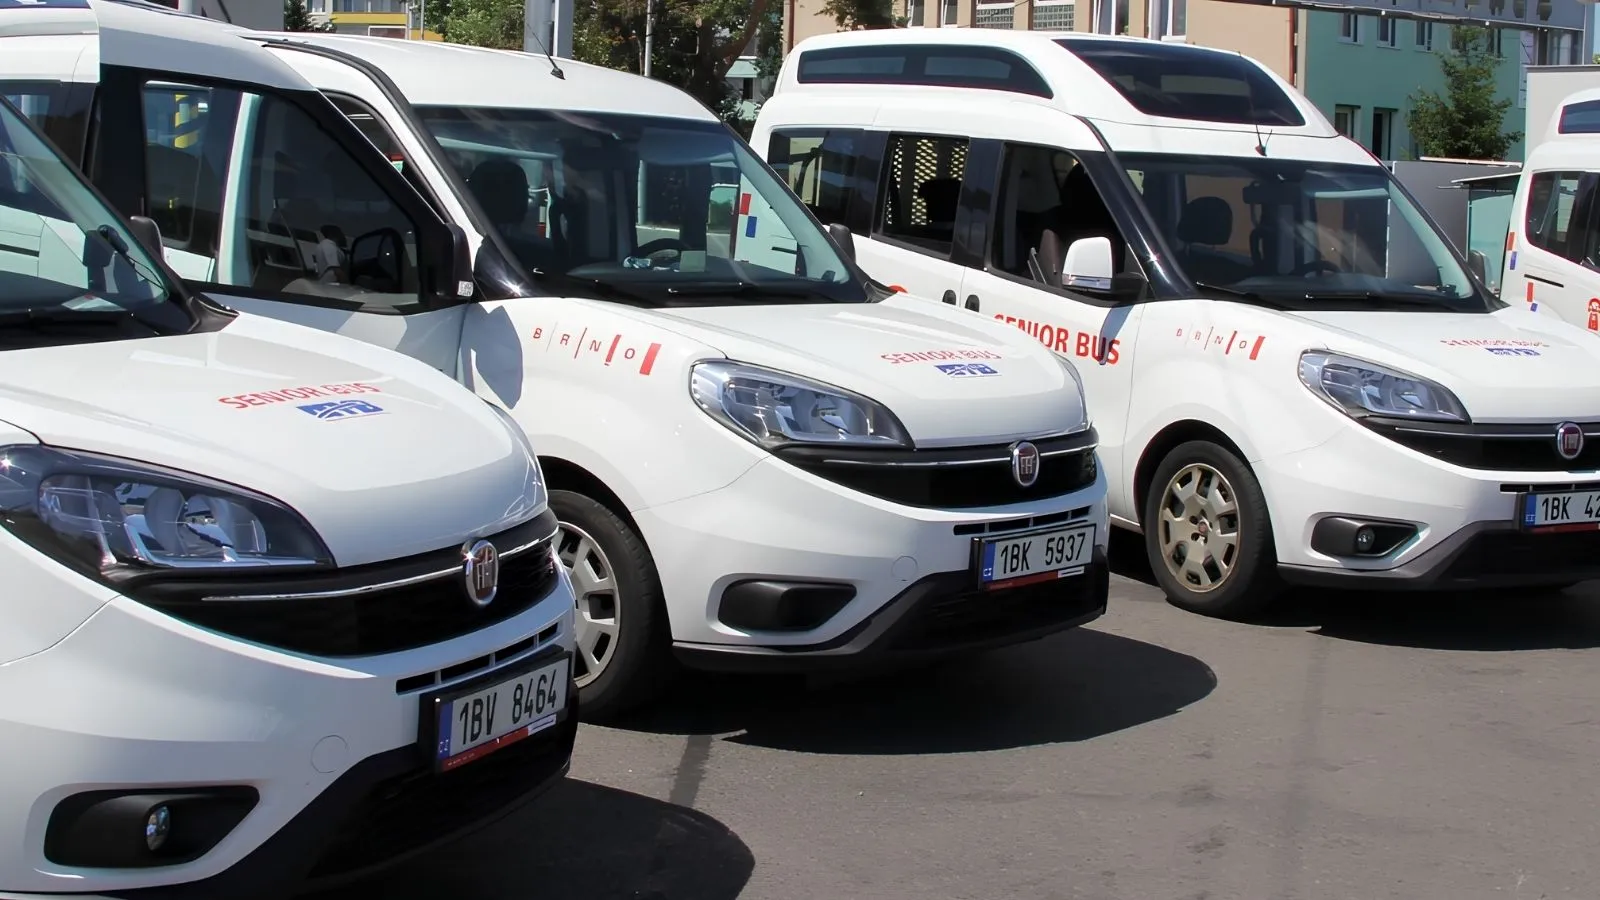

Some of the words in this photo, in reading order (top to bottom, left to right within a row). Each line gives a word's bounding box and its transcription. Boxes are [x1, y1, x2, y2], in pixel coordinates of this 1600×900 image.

[1076, 332, 1120, 365] BUS
[218, 386, 320, 409] SENIOR
[1541, 495, 1571, 521] 1BK
[1000, 541, 1032, 575] 1BK
[1045, 532, 1086, 566] 5937
[459, 692, 498, 746] 1BV
[512, 668, 557, 725] 8464
